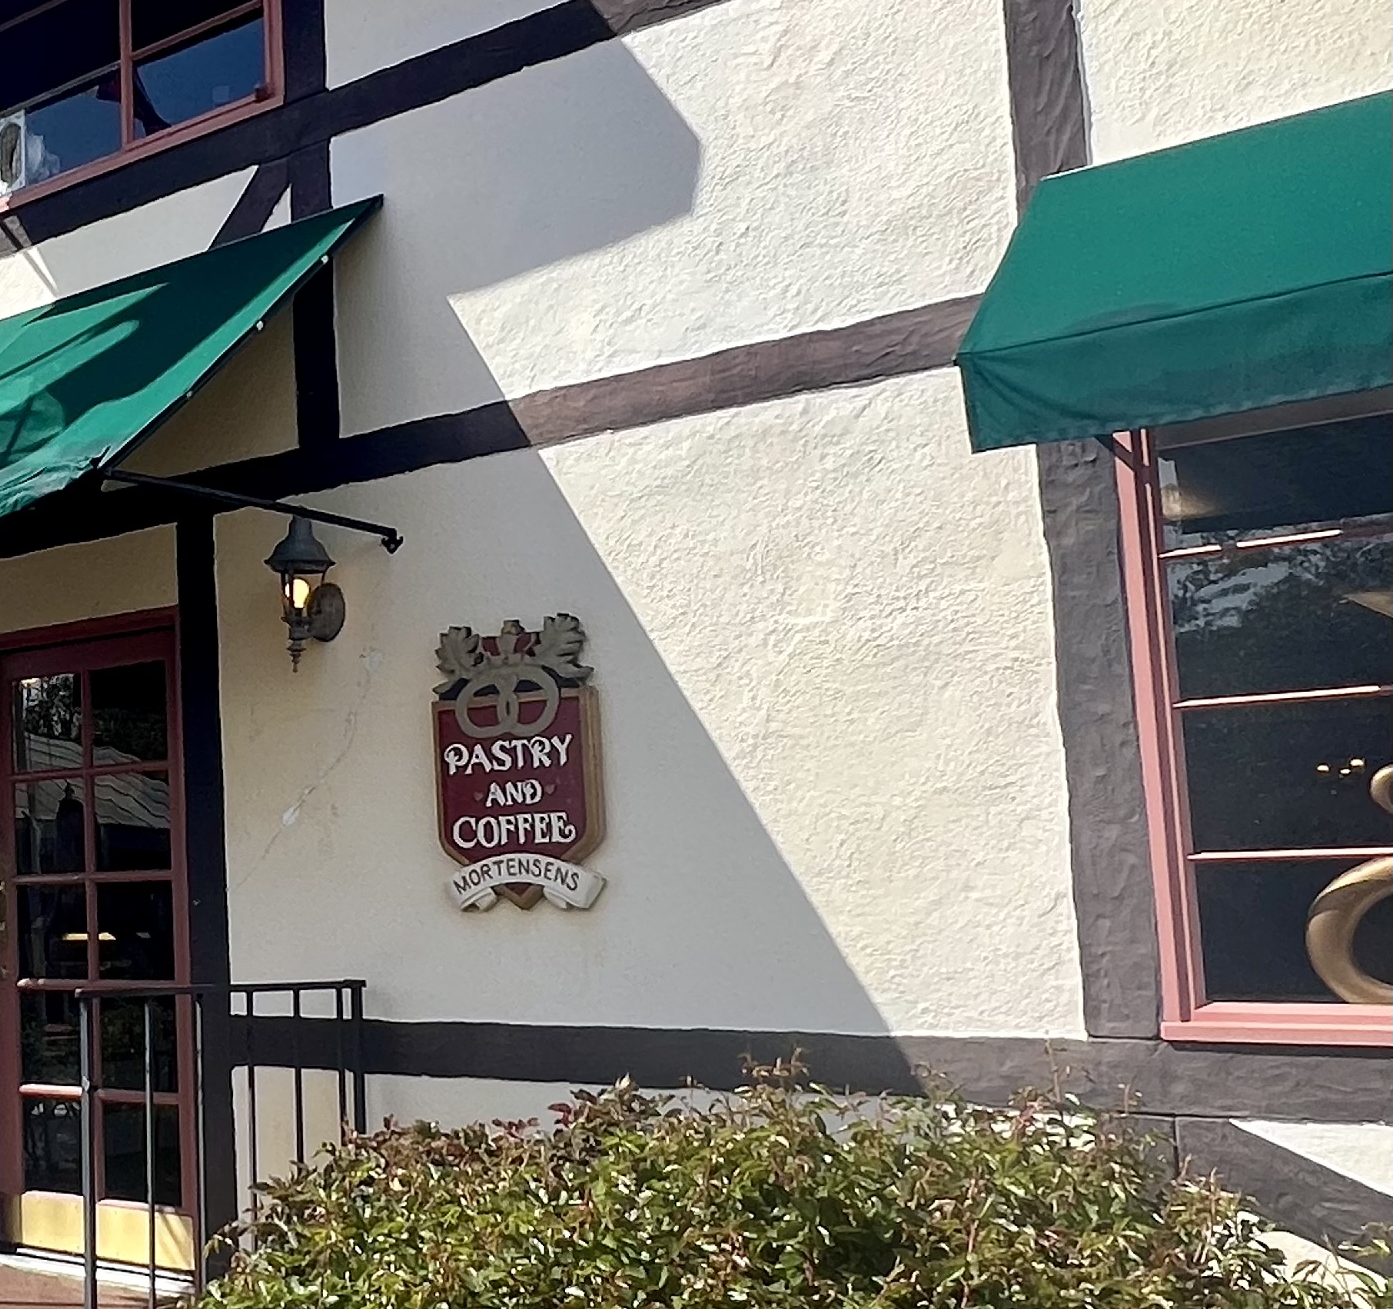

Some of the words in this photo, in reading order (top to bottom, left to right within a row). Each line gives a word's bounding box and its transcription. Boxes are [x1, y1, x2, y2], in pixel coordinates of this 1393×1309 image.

[443, 734, 573, 775] PASTRY
[485, 779, 542, 807] AND
[452, 811, 576, 849] COFFEE
[453, 857, 580, 895] MORTENSENS
